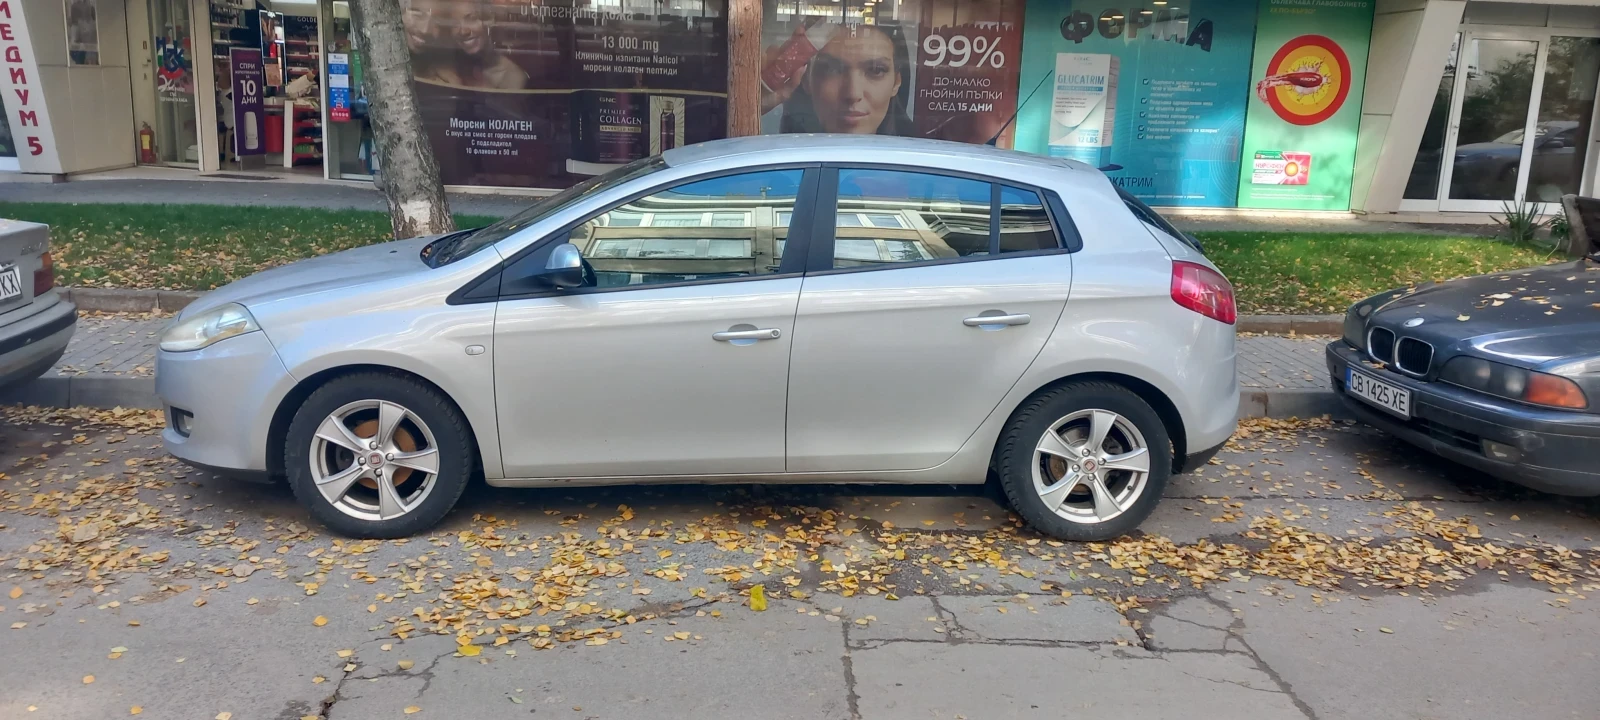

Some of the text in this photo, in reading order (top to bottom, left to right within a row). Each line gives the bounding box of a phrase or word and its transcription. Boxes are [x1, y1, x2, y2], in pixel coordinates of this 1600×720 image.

[520, 4, 634, 21] и стегната кожа
[1060, 8, 1214, 52] ФОРМА
[602, 35, 659, 53] 13 000 mg
[575, 51, 613, 62] Клинично
[615, 55, 650, 64] изпитани
[923, 34, 1005, 69] 99%
[239, 62, 256, 70] СПРИ
[583, 63, 678, 76] морски колаген пептиди
[0, 1, 43, 156] МЕДИУМ 5
[932, 76, 991, 88] ДО-МАЛКО
[1057, 74, 1105, 85] GLUCATRIM
[240, 80, 256, 96] 10
[919, 87, 1003, 101] ГНОЙНИ ПЪПКИ
[241, 96, 257, 105] ДНИ
[928, 101, 993, 113] СЛЕД 15 ДНИ
[449, 117, 533, 132] Морски КОЛАГЕН
[599, 115, 642, 125] COLLAGEN
[466, 147, 472, 155] 10
[473, 148, 497, 156] флакона
[1108, 176, 1153, 188] КАТРИМ
[1352, 373, 1406, 412] CB 1425 XE
